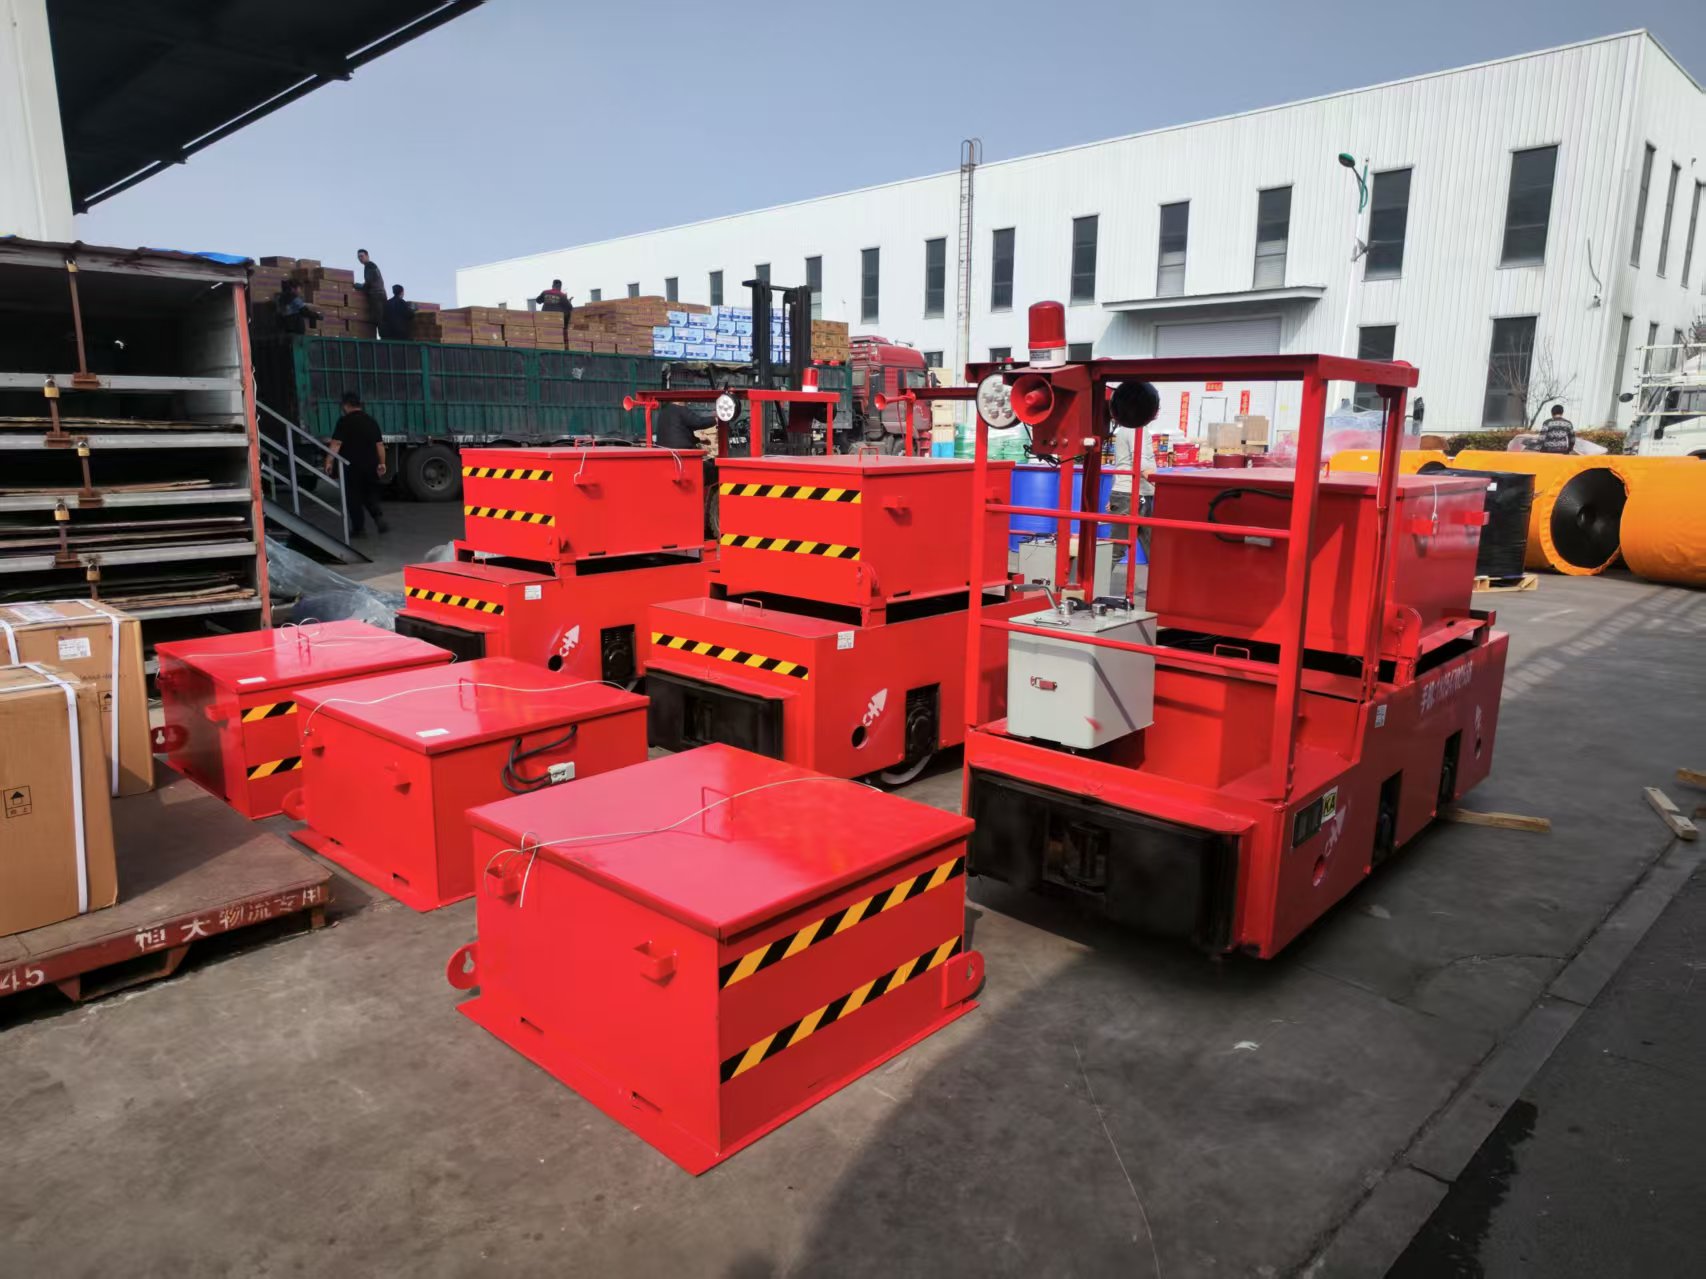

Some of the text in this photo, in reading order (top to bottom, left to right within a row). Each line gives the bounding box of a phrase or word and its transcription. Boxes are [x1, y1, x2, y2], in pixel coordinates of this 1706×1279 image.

[135, 886, 321, 952] 恒大物流专用
